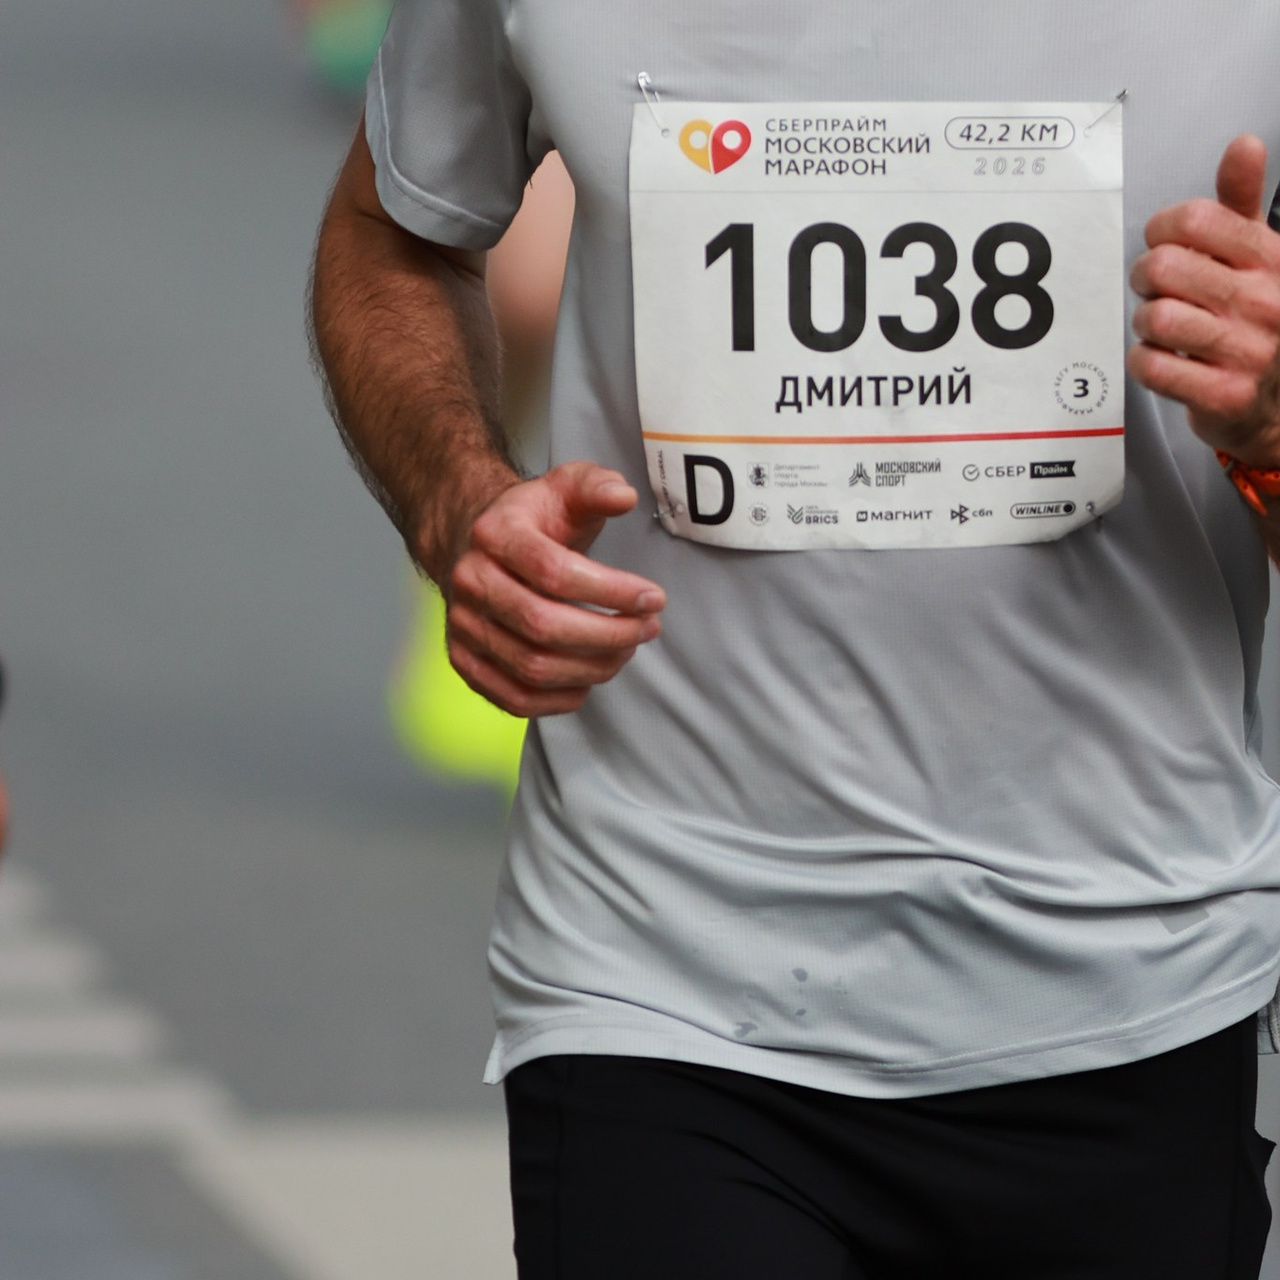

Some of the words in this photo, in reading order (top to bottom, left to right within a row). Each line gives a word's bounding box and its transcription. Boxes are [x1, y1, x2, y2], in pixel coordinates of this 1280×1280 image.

[765, 115, 887, 132] СБЕРПРАЙМ
[959, 123, 1010, 144] 42,2
[764, 133, 931, 154] МОСКОВСКИЙ
[764, 158, 887, 176] МАРАФОН
[973, 156, 1045, 176] 2026
[704, 221, 1055, 353] 1038
[774, 366, 972, 414] ДМИТРИЙ
[1073, 378, 1089, 398] 3
[875, 459, 942, 474] МОСКОВСКИЙ
[984, 466, 1026, 478] СБЕР
[1034, 465, 1068, 476] Прайм
[875, 475, 906, 487] СПОРТ
[683, 454, 735, 526] D
[871, 510, 933, 521] магнит
[972, 508, 993, 517] сбп
[1015, 504, 1061, 515] WINLINE
[805, 515, 839, 525] BRICS
